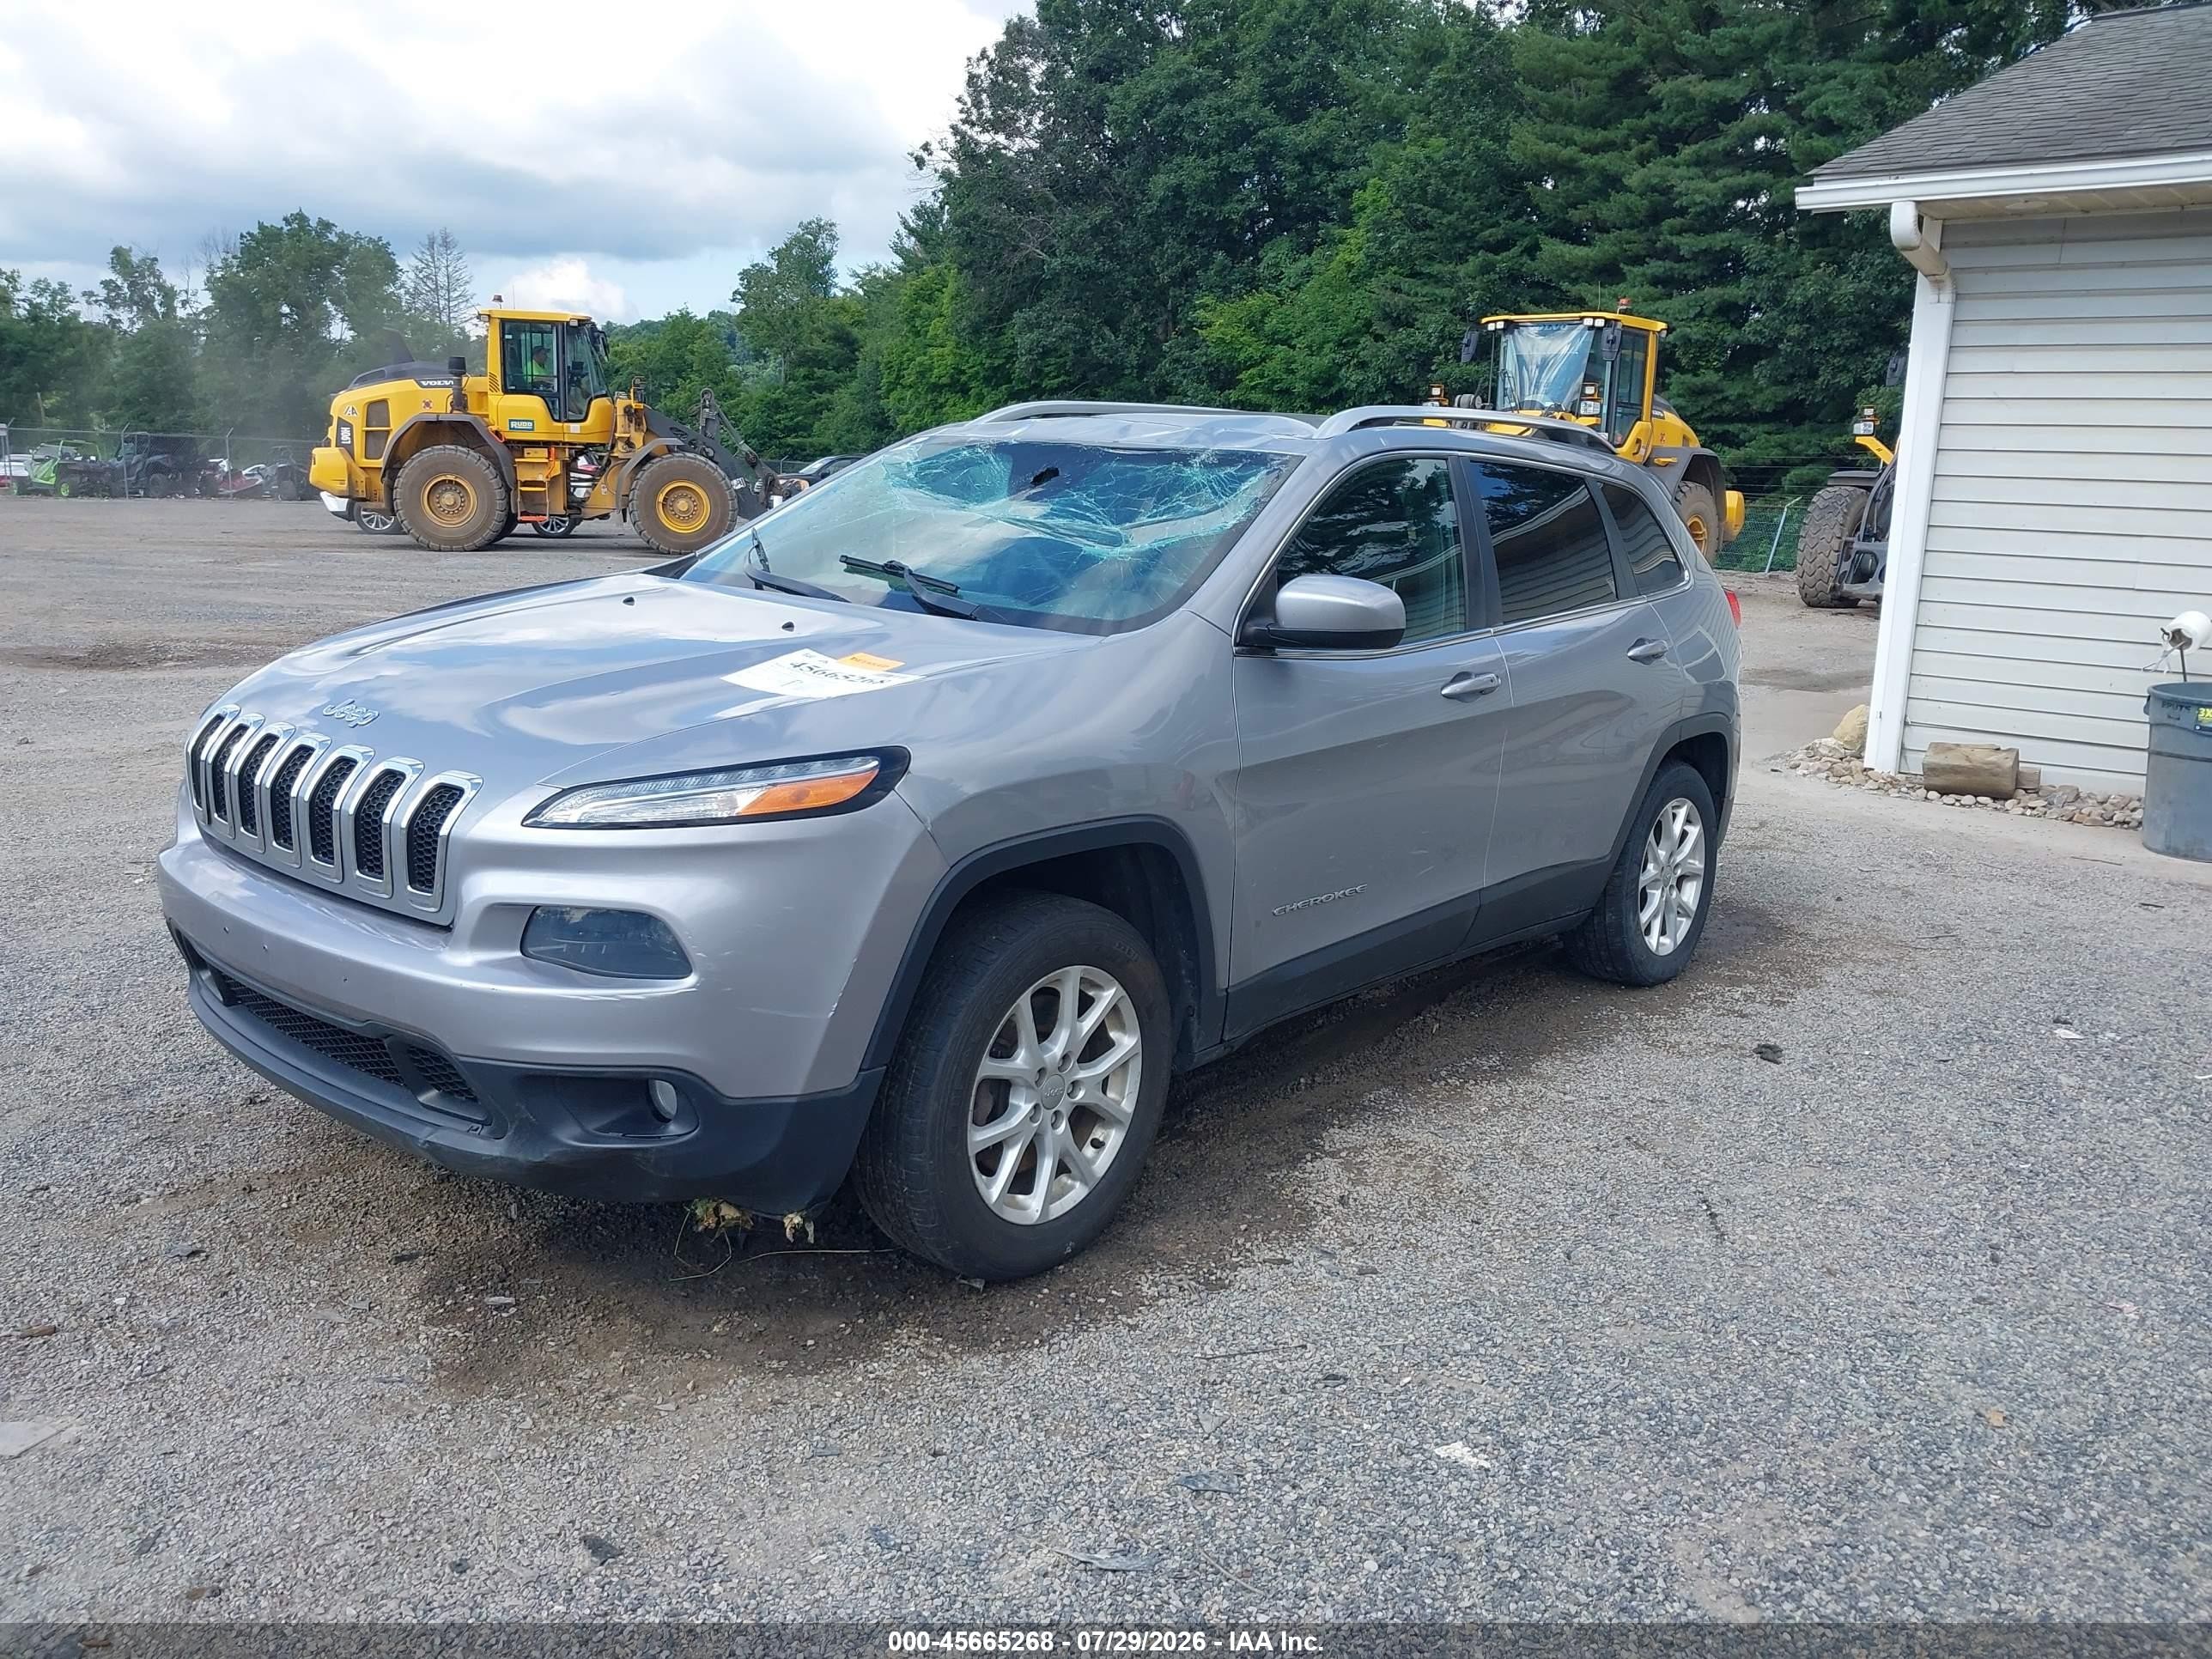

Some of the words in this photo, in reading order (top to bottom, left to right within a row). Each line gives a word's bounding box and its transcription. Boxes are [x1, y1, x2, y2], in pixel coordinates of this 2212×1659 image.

[510, 421, 533, 429] RUDD
[323, 698, 380, 729] Jeep
[1272, 883, 1368, 916] CHEROKEE
